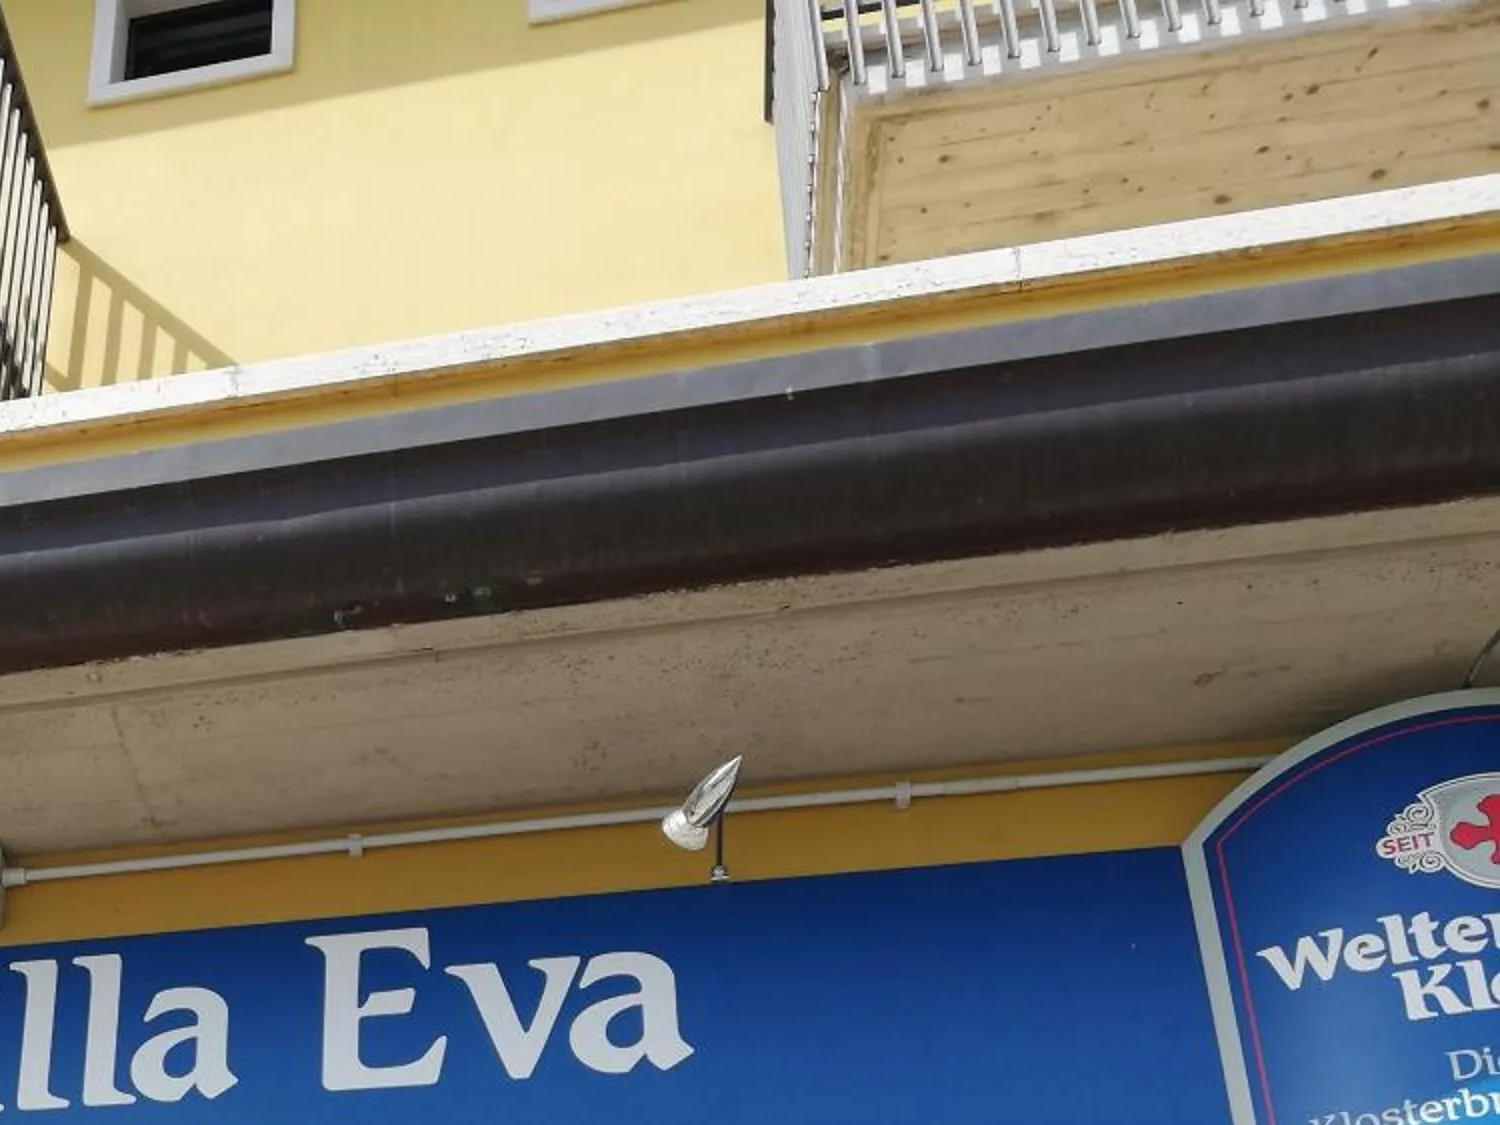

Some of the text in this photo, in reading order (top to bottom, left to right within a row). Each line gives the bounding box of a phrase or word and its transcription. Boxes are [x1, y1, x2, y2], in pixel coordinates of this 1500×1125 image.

[1382, 831, 1434, 855] SEIT
[305, 927, 694, 1091] Eva
[1392, 959, 1500, 1021] Kl
[1444, 1047, 1500, 1081] Di
